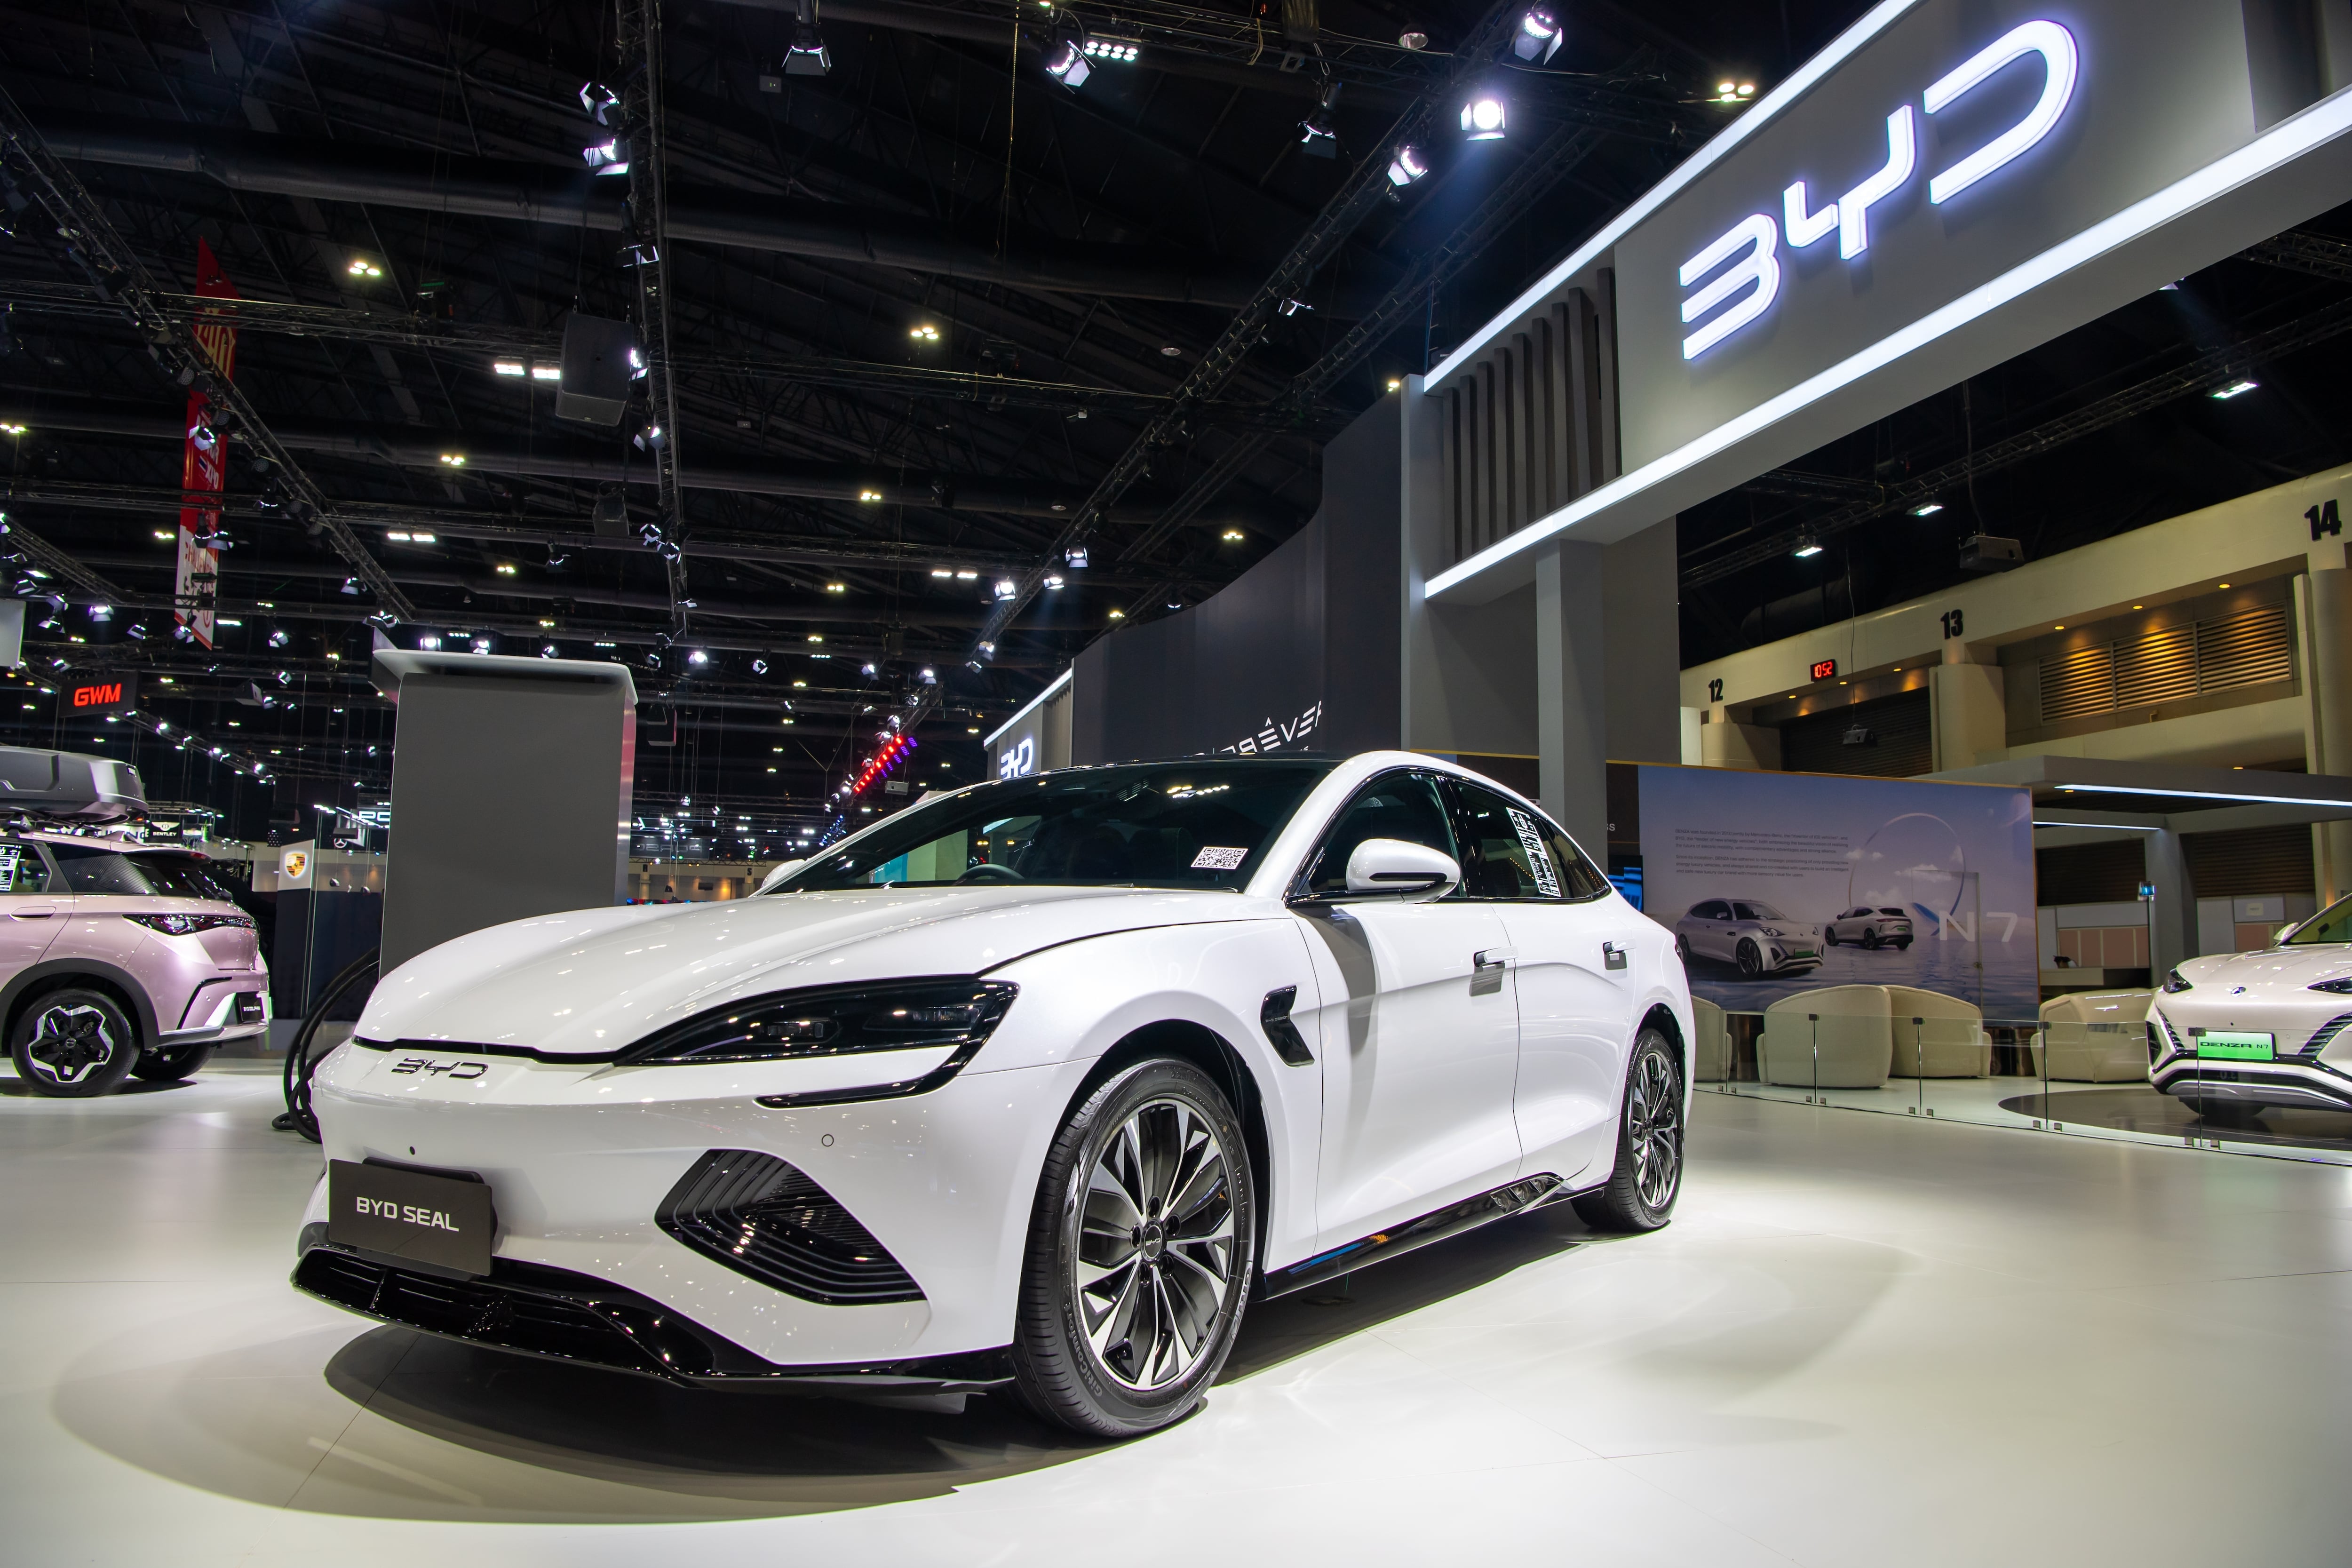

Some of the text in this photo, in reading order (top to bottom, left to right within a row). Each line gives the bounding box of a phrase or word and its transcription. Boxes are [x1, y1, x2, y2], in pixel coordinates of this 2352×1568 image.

[1679, 19, 2078, 360] BYD
[2304, 499, 2342, 541] 14
[1940, 609, 1964, 640] 13
[73, 683, 122, 708] GWM
[1708, 678, 1724, 703] 12
[1000, 738, 1033, 780] BYD
[391, 1057, 489, 1079] BYD
[356, 1196, 460, 1232] BYD SEAL
[1145, 1238, 1161, 1246] BYD
